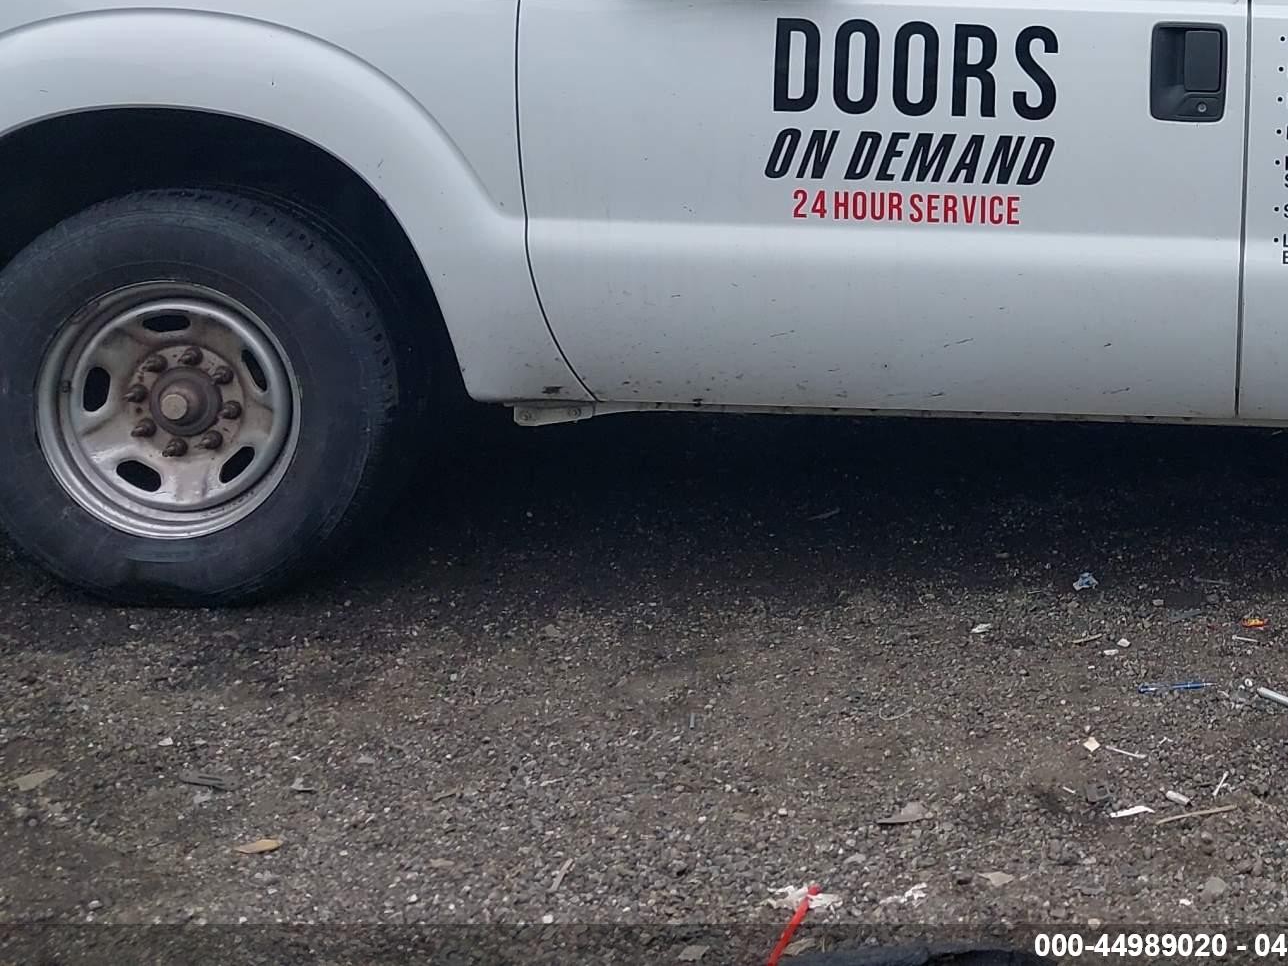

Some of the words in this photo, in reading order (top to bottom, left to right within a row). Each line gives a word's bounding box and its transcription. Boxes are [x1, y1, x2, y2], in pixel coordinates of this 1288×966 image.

[773, 17, 1059, 121] DOORS
[764, 128, 841, 179] ON
[843, 130, 1056, 186] DEMAND
[792, 189, 828, 219] 24
[833, 191, 903, 221] HOUR
[909, 193, 1020, 225] SERVICE
